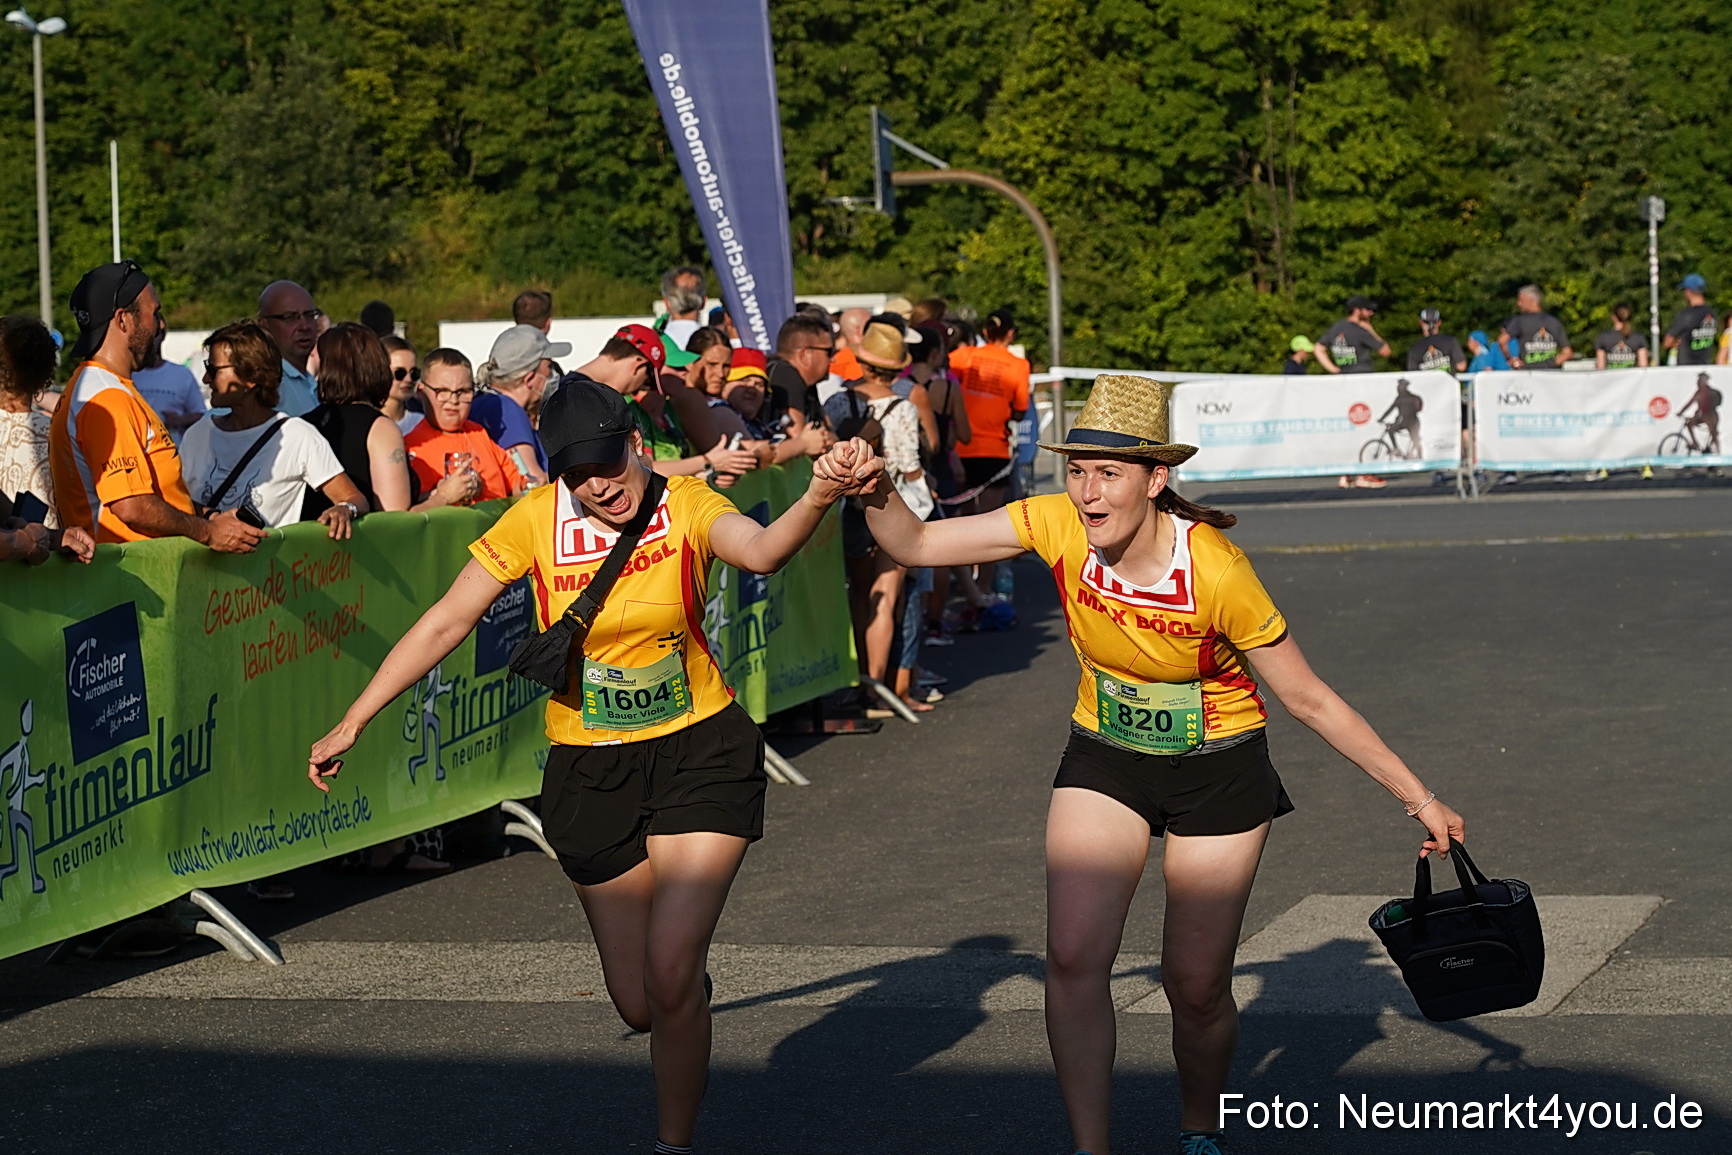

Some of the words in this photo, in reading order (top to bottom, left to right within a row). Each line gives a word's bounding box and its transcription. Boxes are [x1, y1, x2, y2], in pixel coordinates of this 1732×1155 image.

[1197, 402, 1232, 416] NOW
[1498, 393, 1533, 406] NOW
[554, 570, 598, 592] MA
[620, 541, 678, 578] BÖGL
[204, 558, 287, 635] Gesunde
[292, 551, 351, 600] Firmen
[1077, 588, 1128, 626] MAX
[1136, 613, 1201, 636] BÖGL
[243, 620, 298, 682] laufen
[303, 584, 366, 659] länger!
[80, 652, 126, 689] Fischer
[85, 675, 124, 701] AUTOMOBILE
[586, 691, 598, 715] RUN
[598, 681, 672, 711] 1604
[672, 678, 686, 708] 2022
[607, 710, 638, 720] Bauer
[640, 706, 666, 718] Viola
[1101, 700, 1110, 726] RUN
[1117, 703, 1172, 733] 820
[1110, 721, 1144, 740] Wagner
[1147, 733, 1186, 743] Carolin
[1187, 713, 1197, 745] 2022
[452, 723, 509, 770] neumarkt
[45, 693, 218, 843] firmenlauf
[167, 786, 372, 876] www.firmenlauf-oberpfalz.de
[53, 819, 124, 878] neumarkt
[1446, 957, 1474, 968] Fischer
